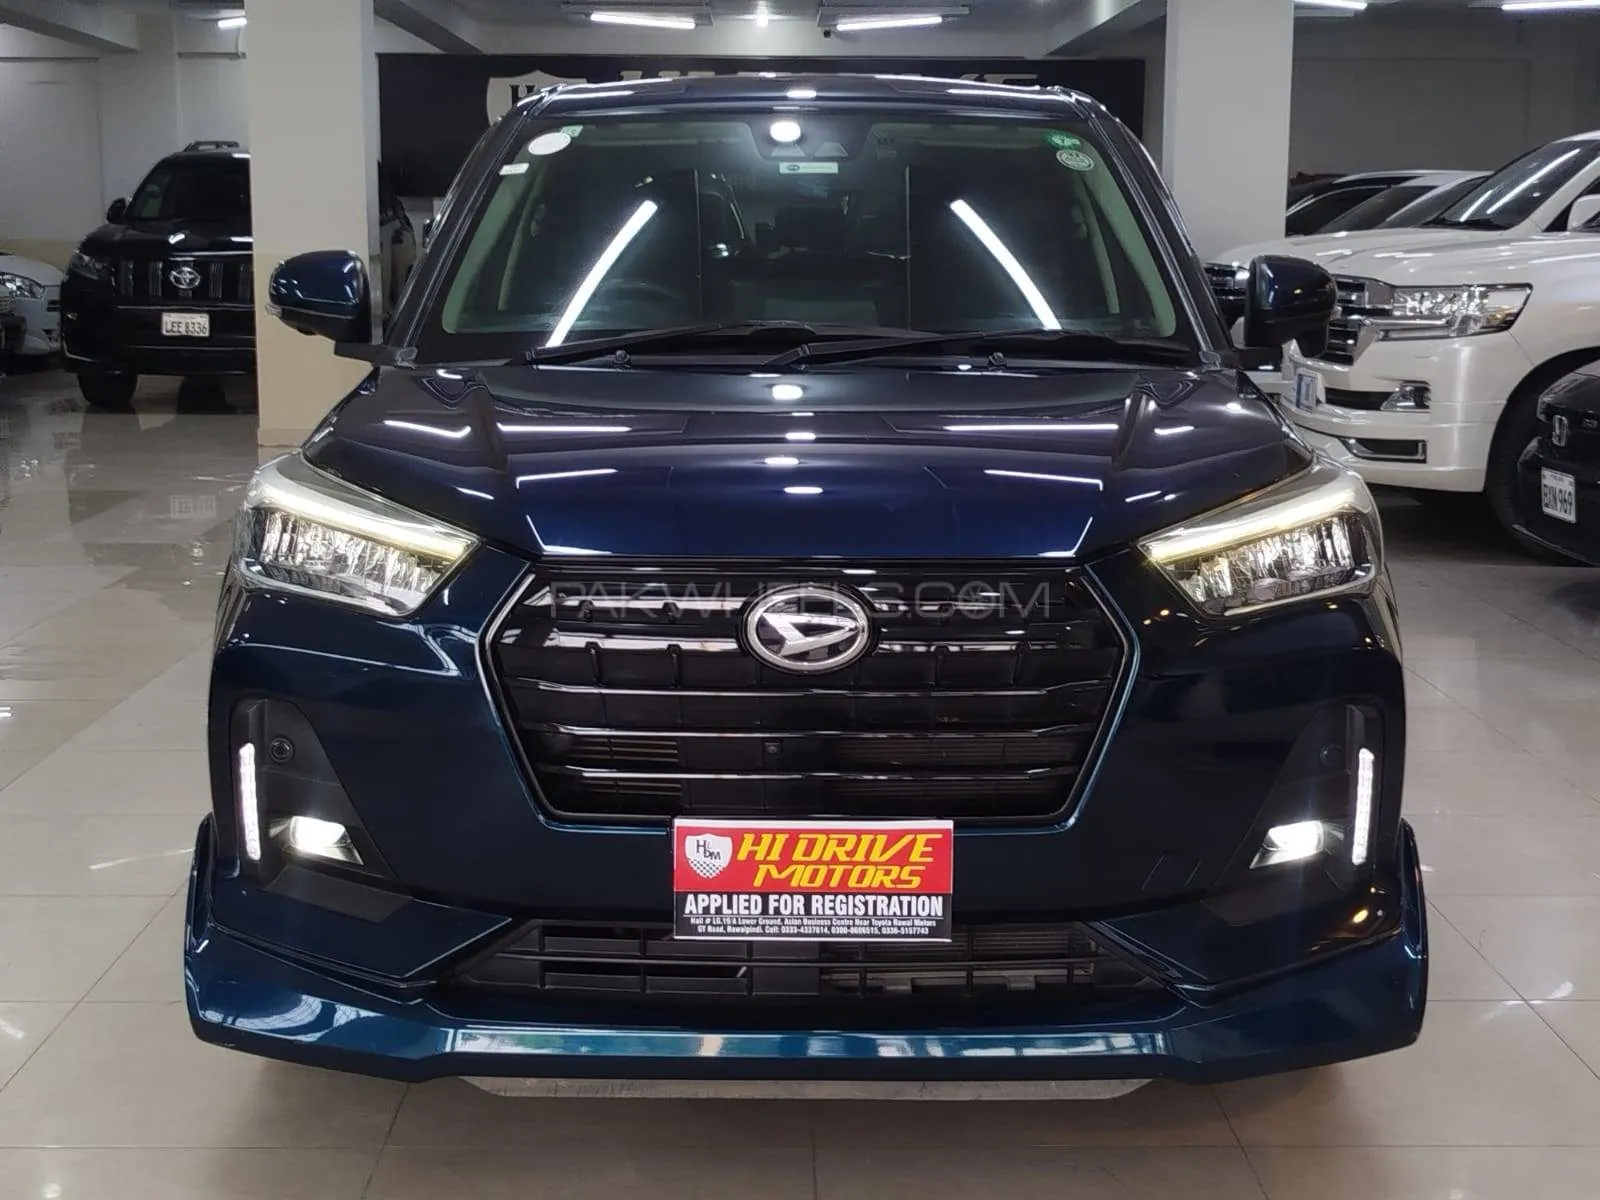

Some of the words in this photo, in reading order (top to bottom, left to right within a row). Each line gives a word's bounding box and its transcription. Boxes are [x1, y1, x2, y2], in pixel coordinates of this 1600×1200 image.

[737, 833, 790, 861] HI
[791, 833, 943, 862] DRIVE
[753, 864, 926, 888] MOTORS
[685, 893, 762, 915] APPLIED
[768, 894, 805, 915] FOR
[811, 894, 943, 916] REGISTRATION
[738, 917, 757, 925] Lower
[871, 918, 892, 928] Toyota
[913, 919, 936, 927] Motors
